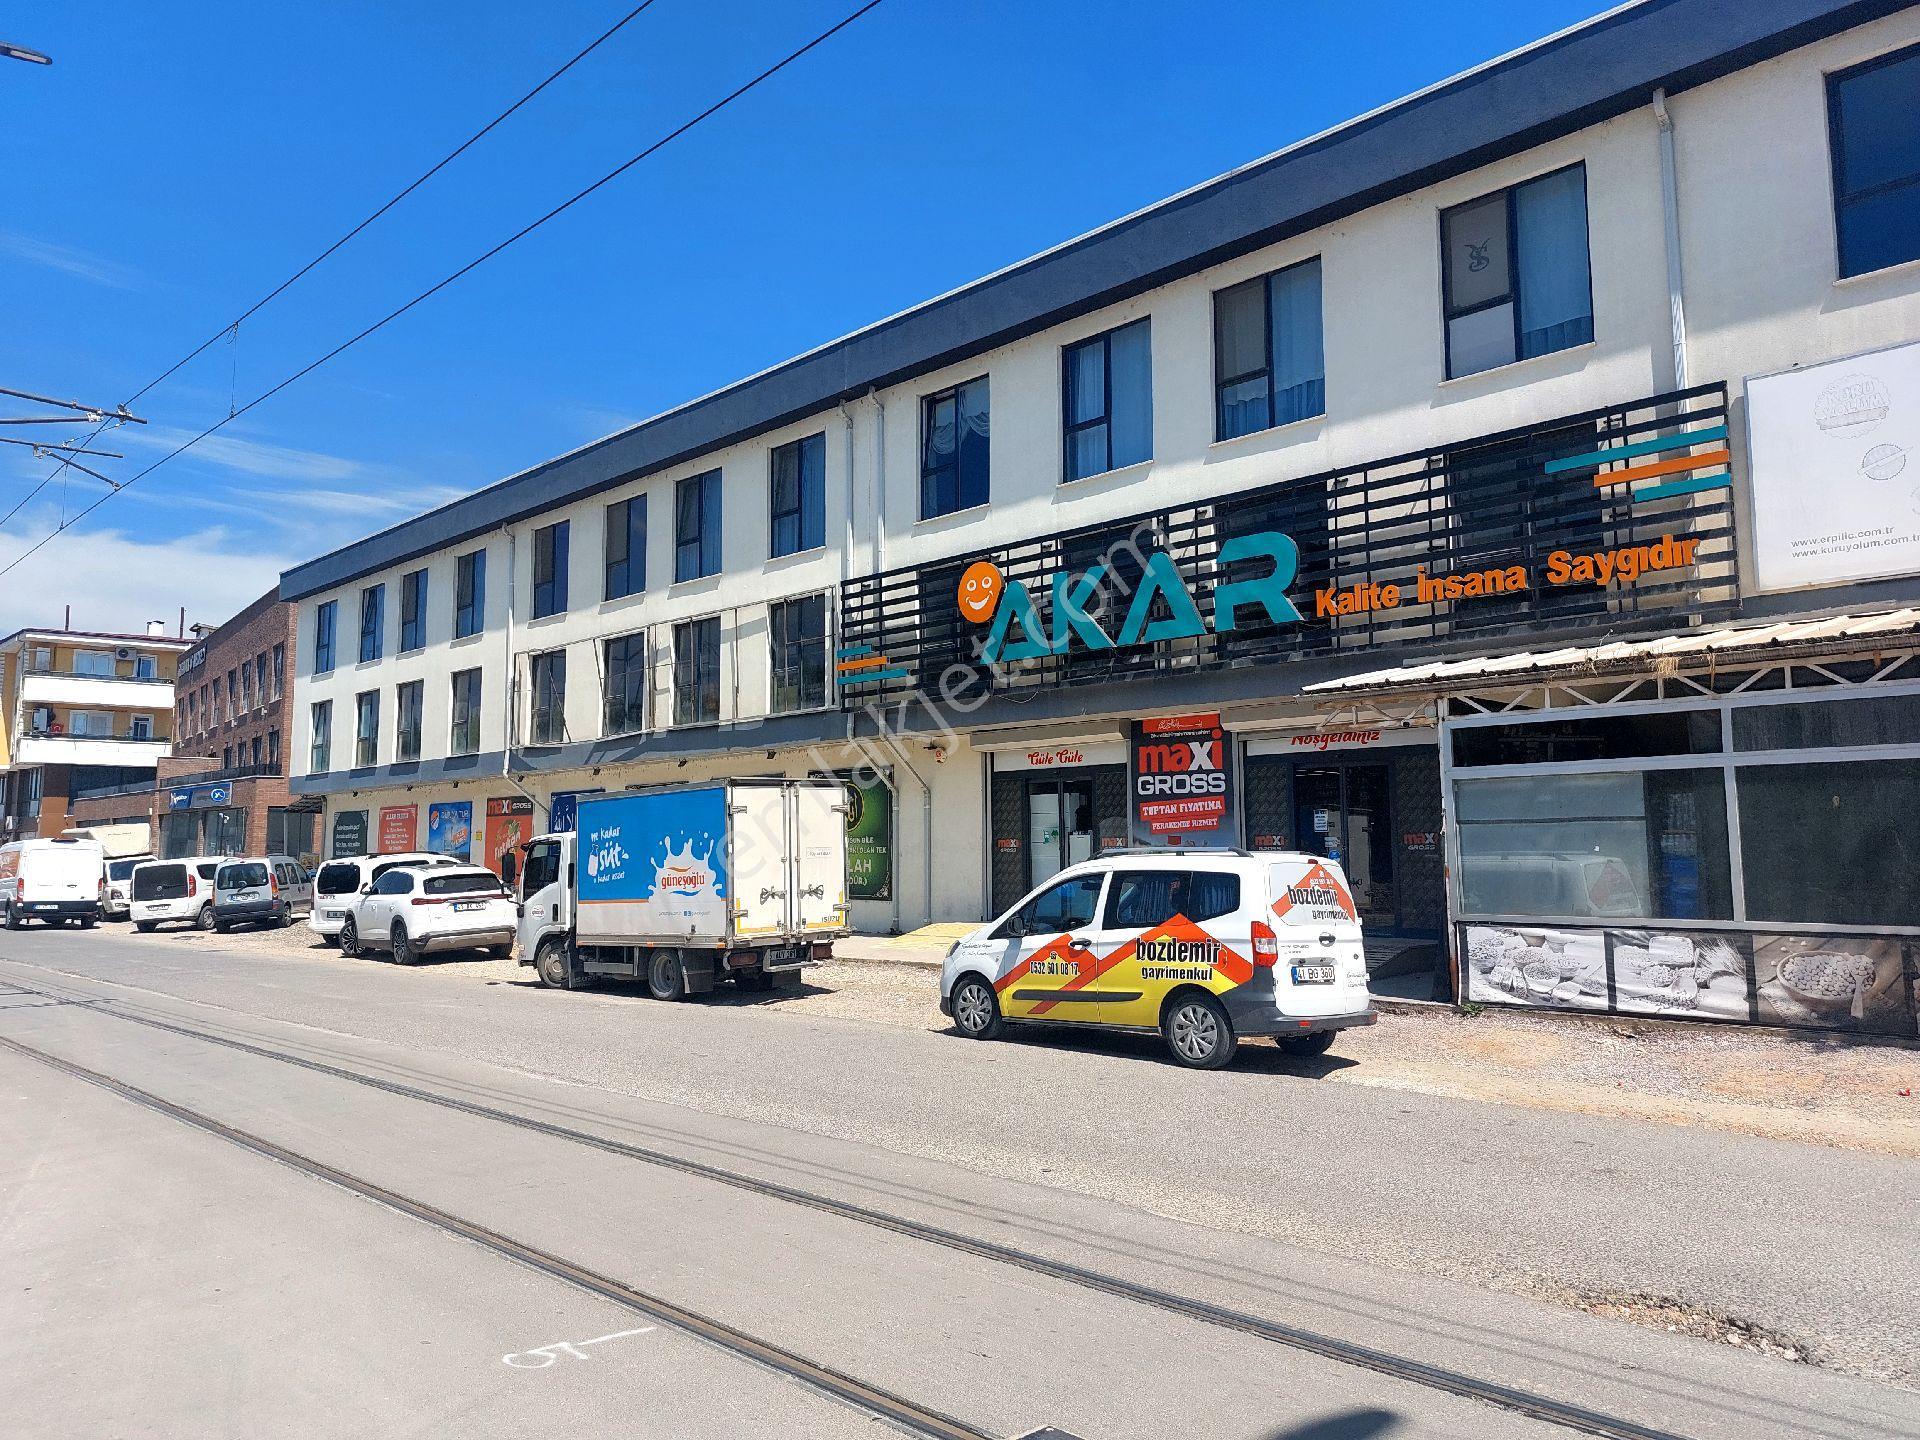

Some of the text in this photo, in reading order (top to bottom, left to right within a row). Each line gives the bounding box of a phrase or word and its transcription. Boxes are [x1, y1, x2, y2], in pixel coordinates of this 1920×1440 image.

[1315, 534, 1700, 618] Kalite İnsana Saygıdır
[978, 530, 1305, 667] AKAR
[1027, 749, 1084, 766] Güle Güle
[1138, 728, 1223, 774] maxi
[1137, 772, 1226, 795] GROSS
[1142, 803, 1178, 816] TOPTAN
[600, 825, 621, 840] kadar
[661, 871, 705, 890] güneşoğlu
[1287, 884, 1338, 907] bozdemir
[1135, 937, 1221, 964] bozdemir
[1030, 961, 1046, 975] 0532
[1141, 965, 1213, 981] gayrimenkul
[1297, 967, 1306, 980] 41
[1307, 967, 1319, 980] BG
